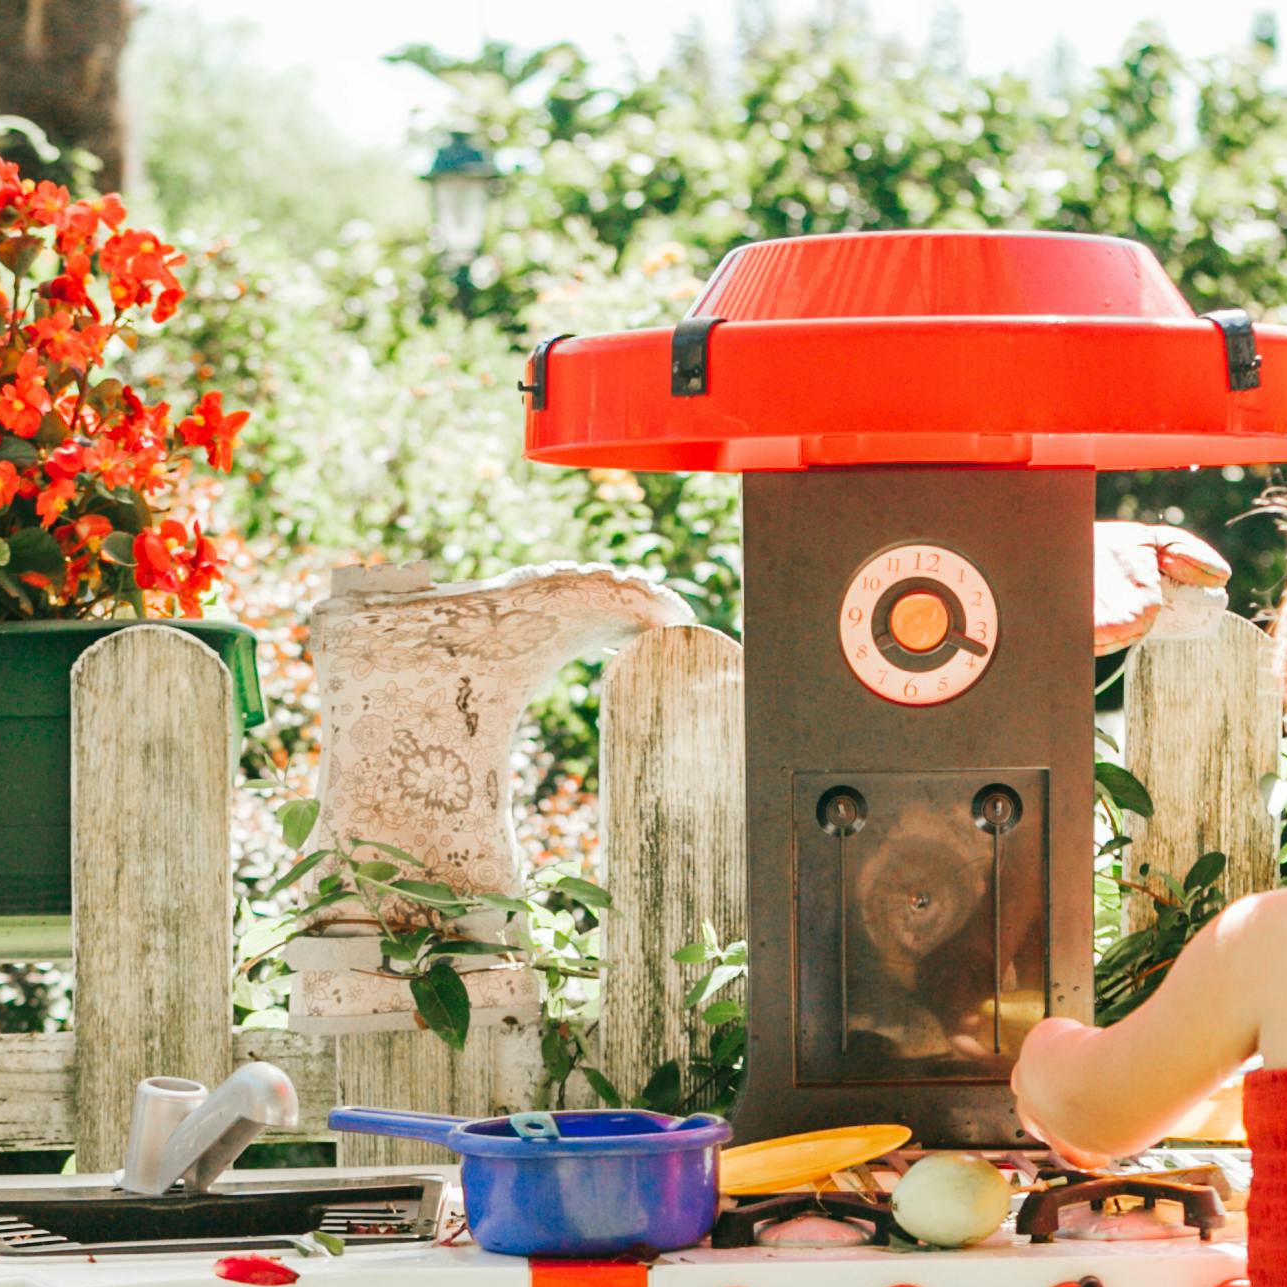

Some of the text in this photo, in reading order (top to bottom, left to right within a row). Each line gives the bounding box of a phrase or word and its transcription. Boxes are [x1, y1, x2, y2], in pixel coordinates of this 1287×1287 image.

[886, 558, 900, 572] 11
[914, 552, 940, 572] 12
[863, 576, 881, 591] 10
[959, 569, 965, 583] 1
[971, 592, 982, 606] 2
[849, 607, 863, 628] 9
[976, 621, 987, 641] 3
[857, 645, 867, 660] 8
[966, 655, 976, 669] 4
[878, 670, 888, 685] 7
[938, 678, 948, 691] 5
[904, 678, 917, 697] 6
